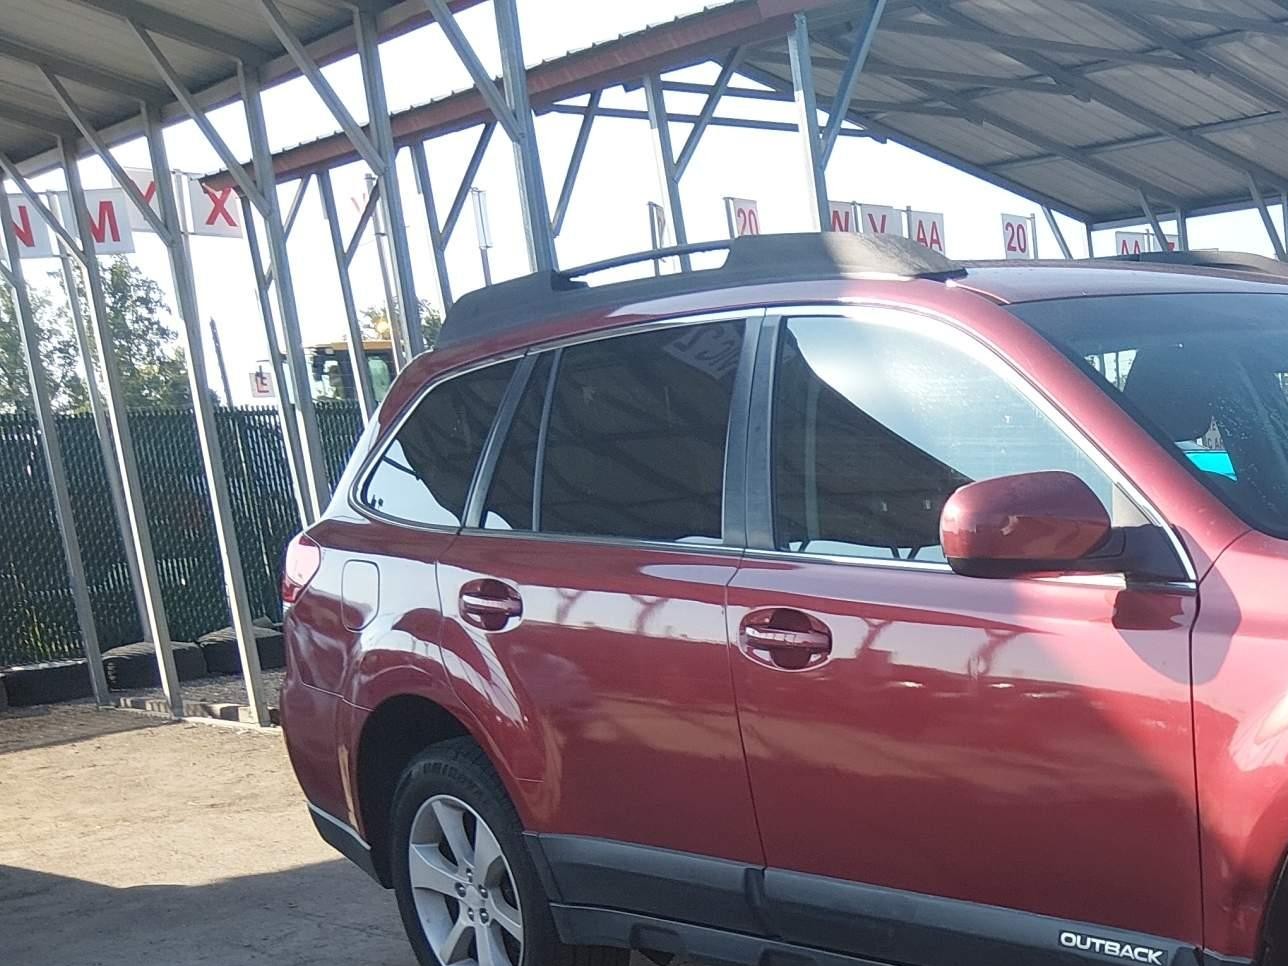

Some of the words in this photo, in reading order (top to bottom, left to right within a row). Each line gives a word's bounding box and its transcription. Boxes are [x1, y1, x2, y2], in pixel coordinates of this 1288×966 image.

[916, 219, 943, 251] AA
[1004, 222, 1028, 254] 20
[1059, 931, 1164, 966] OUTBACK
